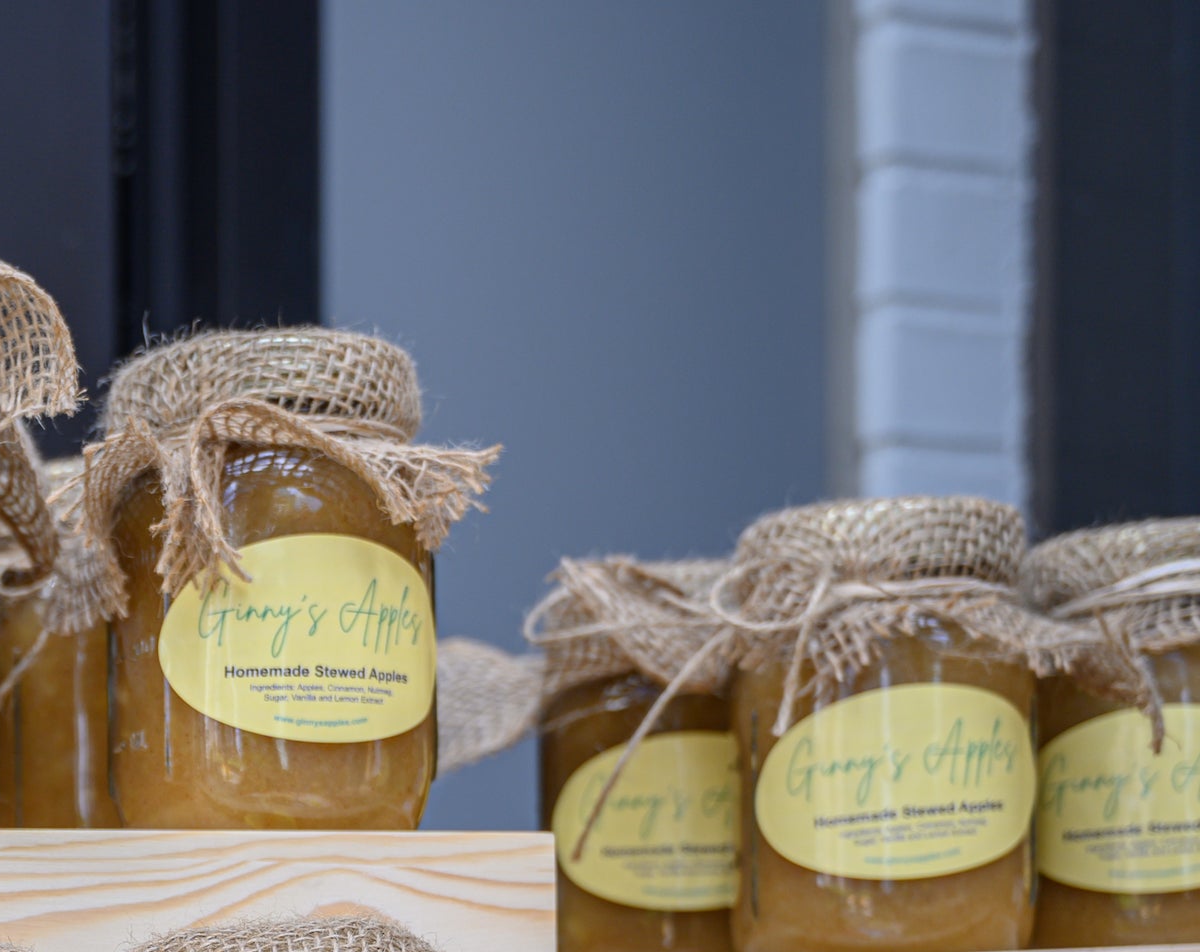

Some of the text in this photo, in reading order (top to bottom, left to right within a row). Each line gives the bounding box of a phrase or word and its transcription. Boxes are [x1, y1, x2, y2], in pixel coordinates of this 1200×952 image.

[198, 578, 424, 658] Ginny's Apples
[224, 666, 408, 684] Homemade Stewed Apples
